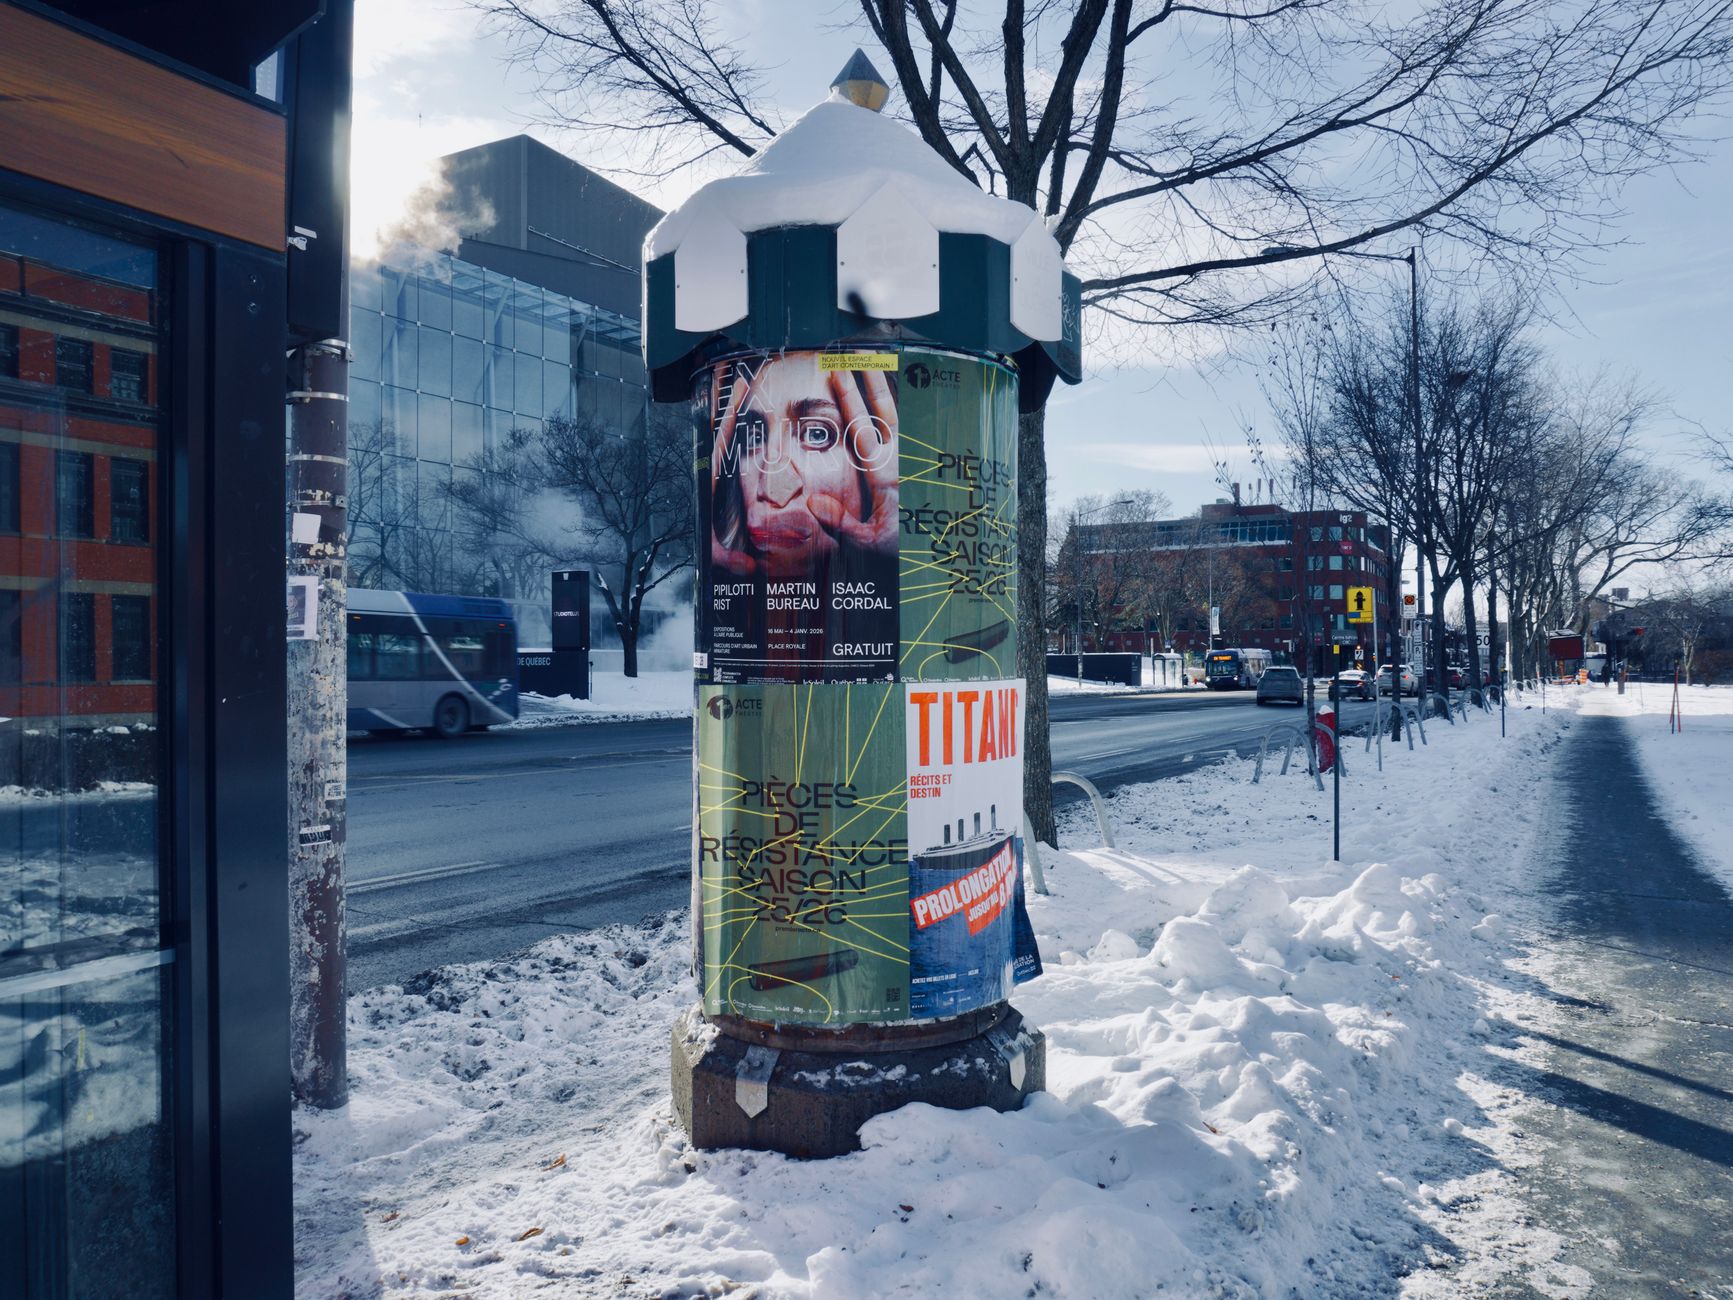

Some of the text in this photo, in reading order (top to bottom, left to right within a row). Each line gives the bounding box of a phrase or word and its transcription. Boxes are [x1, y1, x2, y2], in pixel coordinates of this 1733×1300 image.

[714, 357, 775, 421] EX
[932, 369, 961, 382] ACTE
[713, 415, 894, 480] MURO
[937, 449, 1010, 488] PIÈCES
[969, 485, 997, 512] DE
[931, 539, 1012, 569] SAISON
[713, 584, 754, 596] PIPILOTTI
[766, 583, 816, 595] MARTIN
[832, 582, 875, 594] ISAAC
[948, 568, 1007, 597] 25/26
[713, 598, 731, 611] RIST
[766, 597, 820, 610] BUREAU
[832, 597, 892, 610] CORDAL
[525, 656, 551, 667] QUÉBEC
[832, 643, 894, 656] GRATUIT
[735, 699, 762, 710] ACTE
[910, 688, 1019, 767] TITANI
[742, 775, 859, 809] PIÈCES
[910, 773, 952, 786] RÉCITS ET
[910, 787, 941, 798] DESTIN
[774, 810, 820, 838] DE
[700, 829, 909, 867] RÉSISTANCE
[737, 867, 867, 896] SAISON
[913, 841, 1011, 926] PROLONGATION
[752, 897, 849, 925] 25/26
